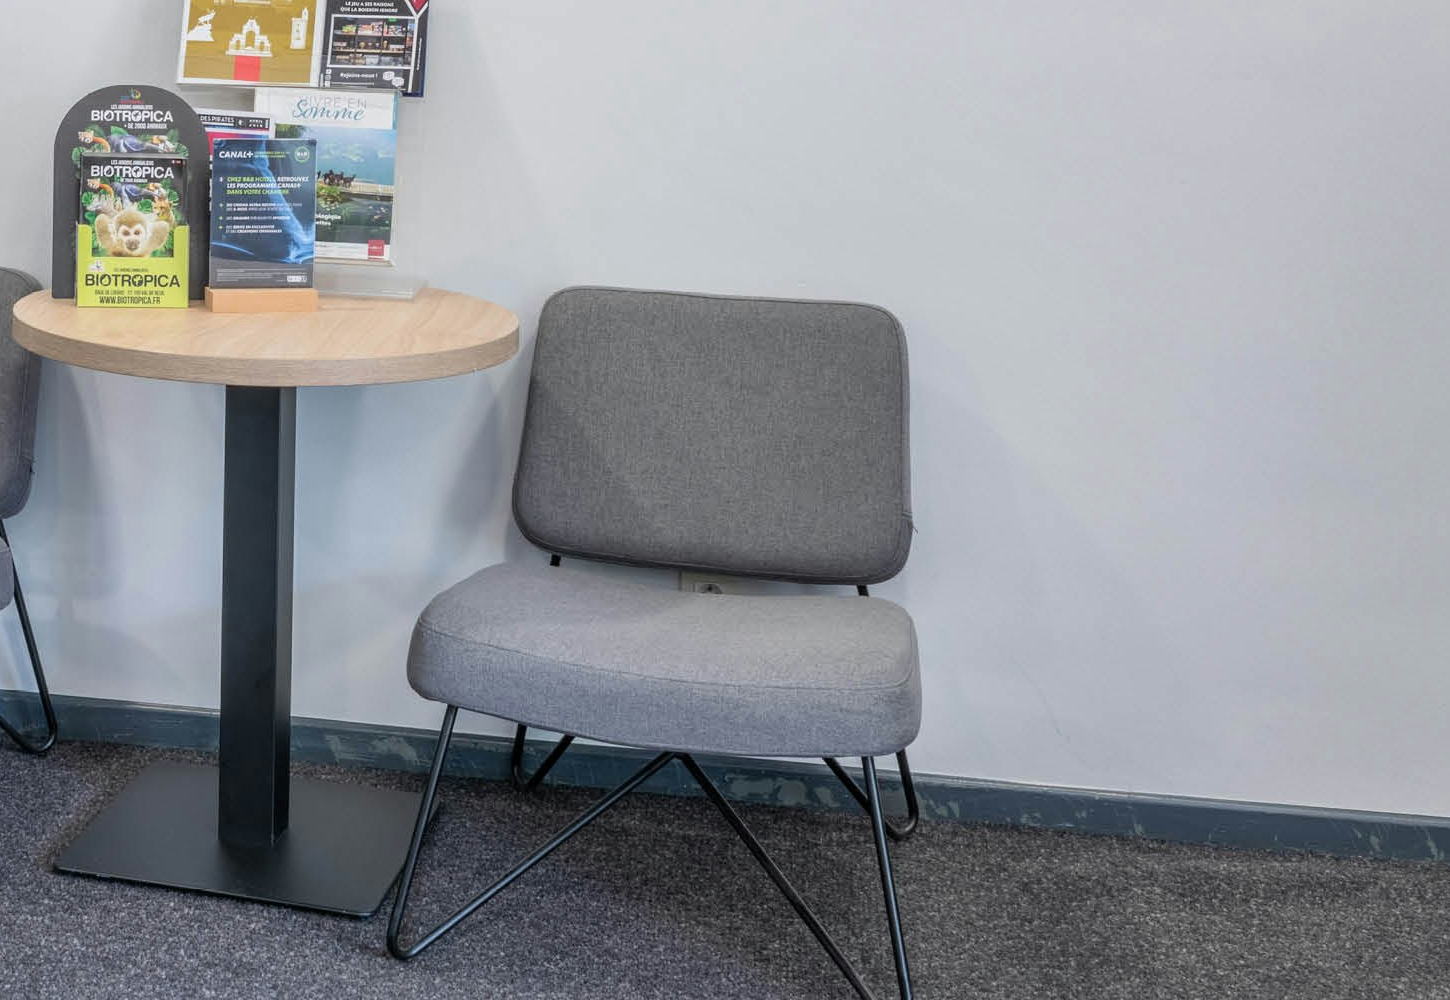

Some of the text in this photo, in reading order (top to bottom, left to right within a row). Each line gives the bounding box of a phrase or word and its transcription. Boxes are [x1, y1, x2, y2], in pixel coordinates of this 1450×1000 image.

[91, 110, 173, 122] BIOTROPICA
[292, 99, 365, 121] Somme
[219, 150, 253, 158] CANAL+
[91, 165, 174, 178] BIOTROPICA
[85, 274, 180, 287] BIOTROPICA
